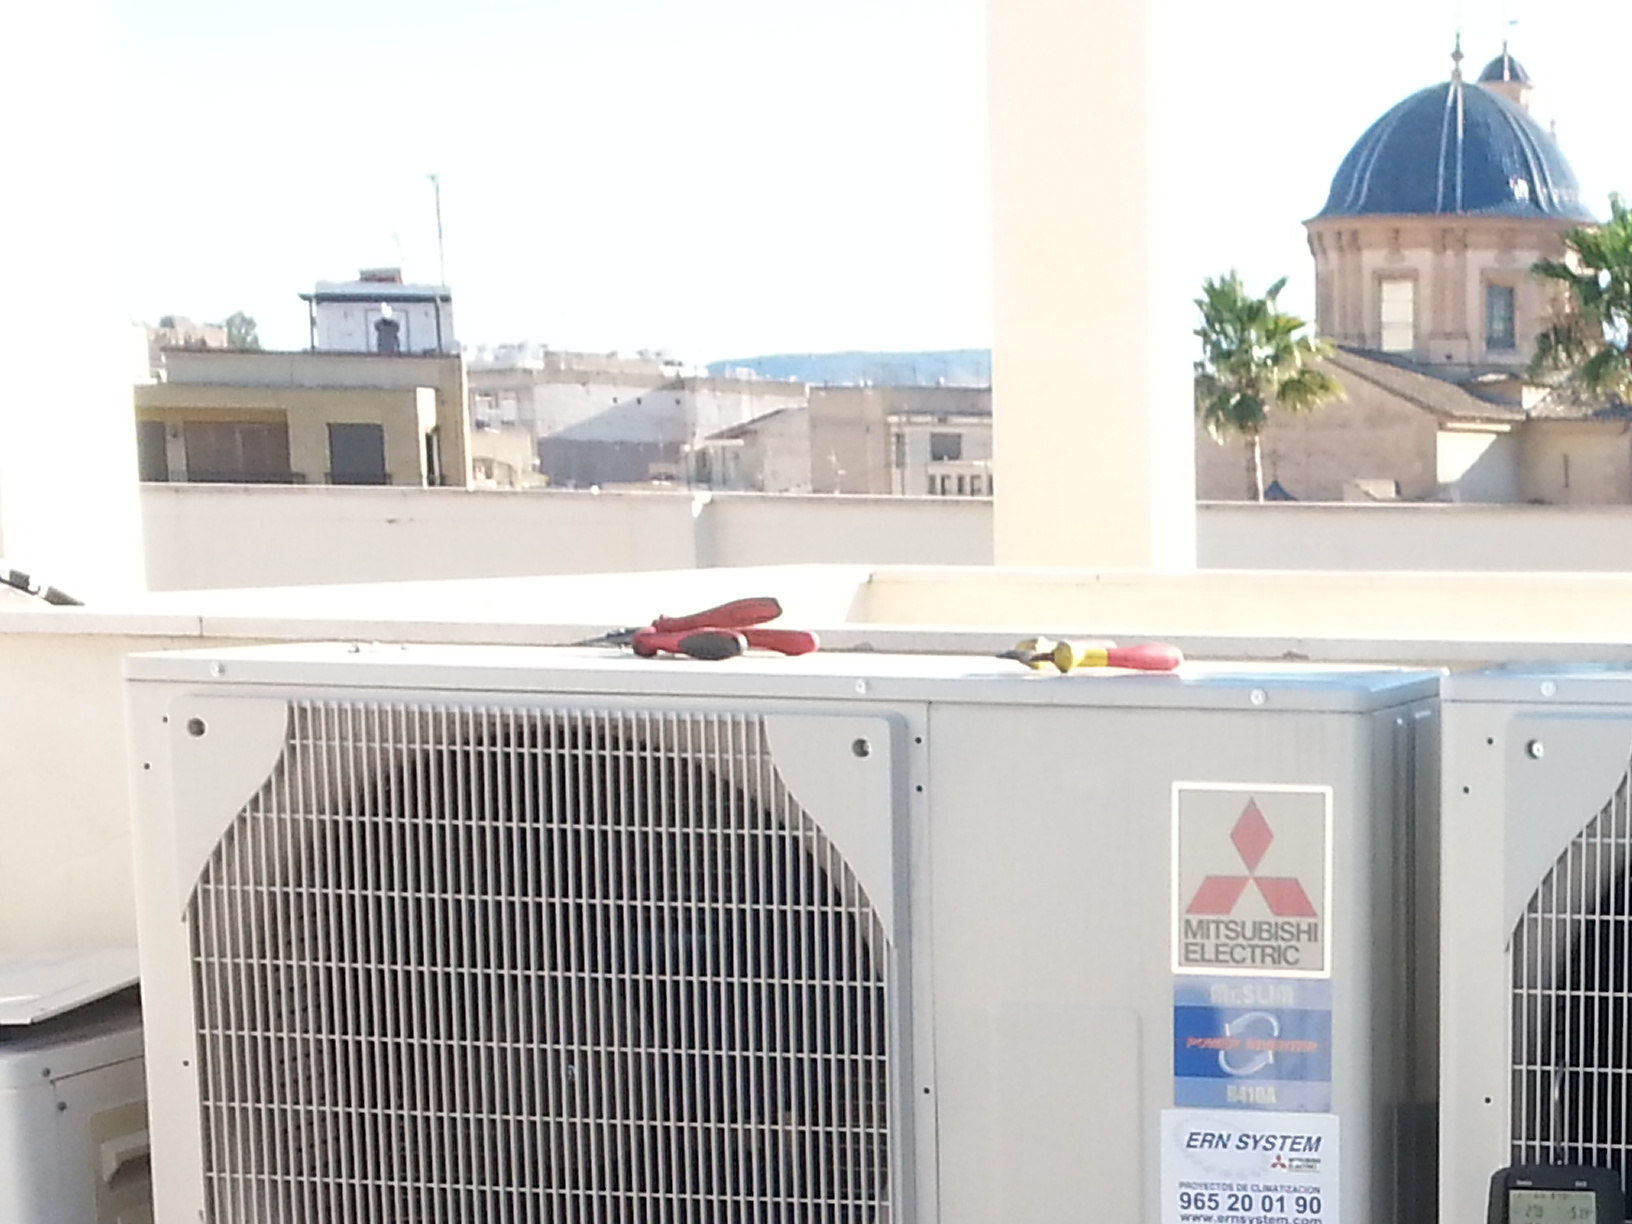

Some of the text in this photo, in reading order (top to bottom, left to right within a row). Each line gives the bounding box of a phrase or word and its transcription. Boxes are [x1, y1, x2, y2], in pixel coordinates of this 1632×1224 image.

[1184, 919, 1318, 943] MITSUBISHI
[1184, 943, 1300, 966] ELECTRIC
[1186, 1132, 1322, 1152] ERN SYSTEM
[1179, 1181, 1233, 1192] PROYECTOS
[1236, 1183, 1248, 1192] DE
[1179, 1192, 1321, 1214] 965 20 01 90
